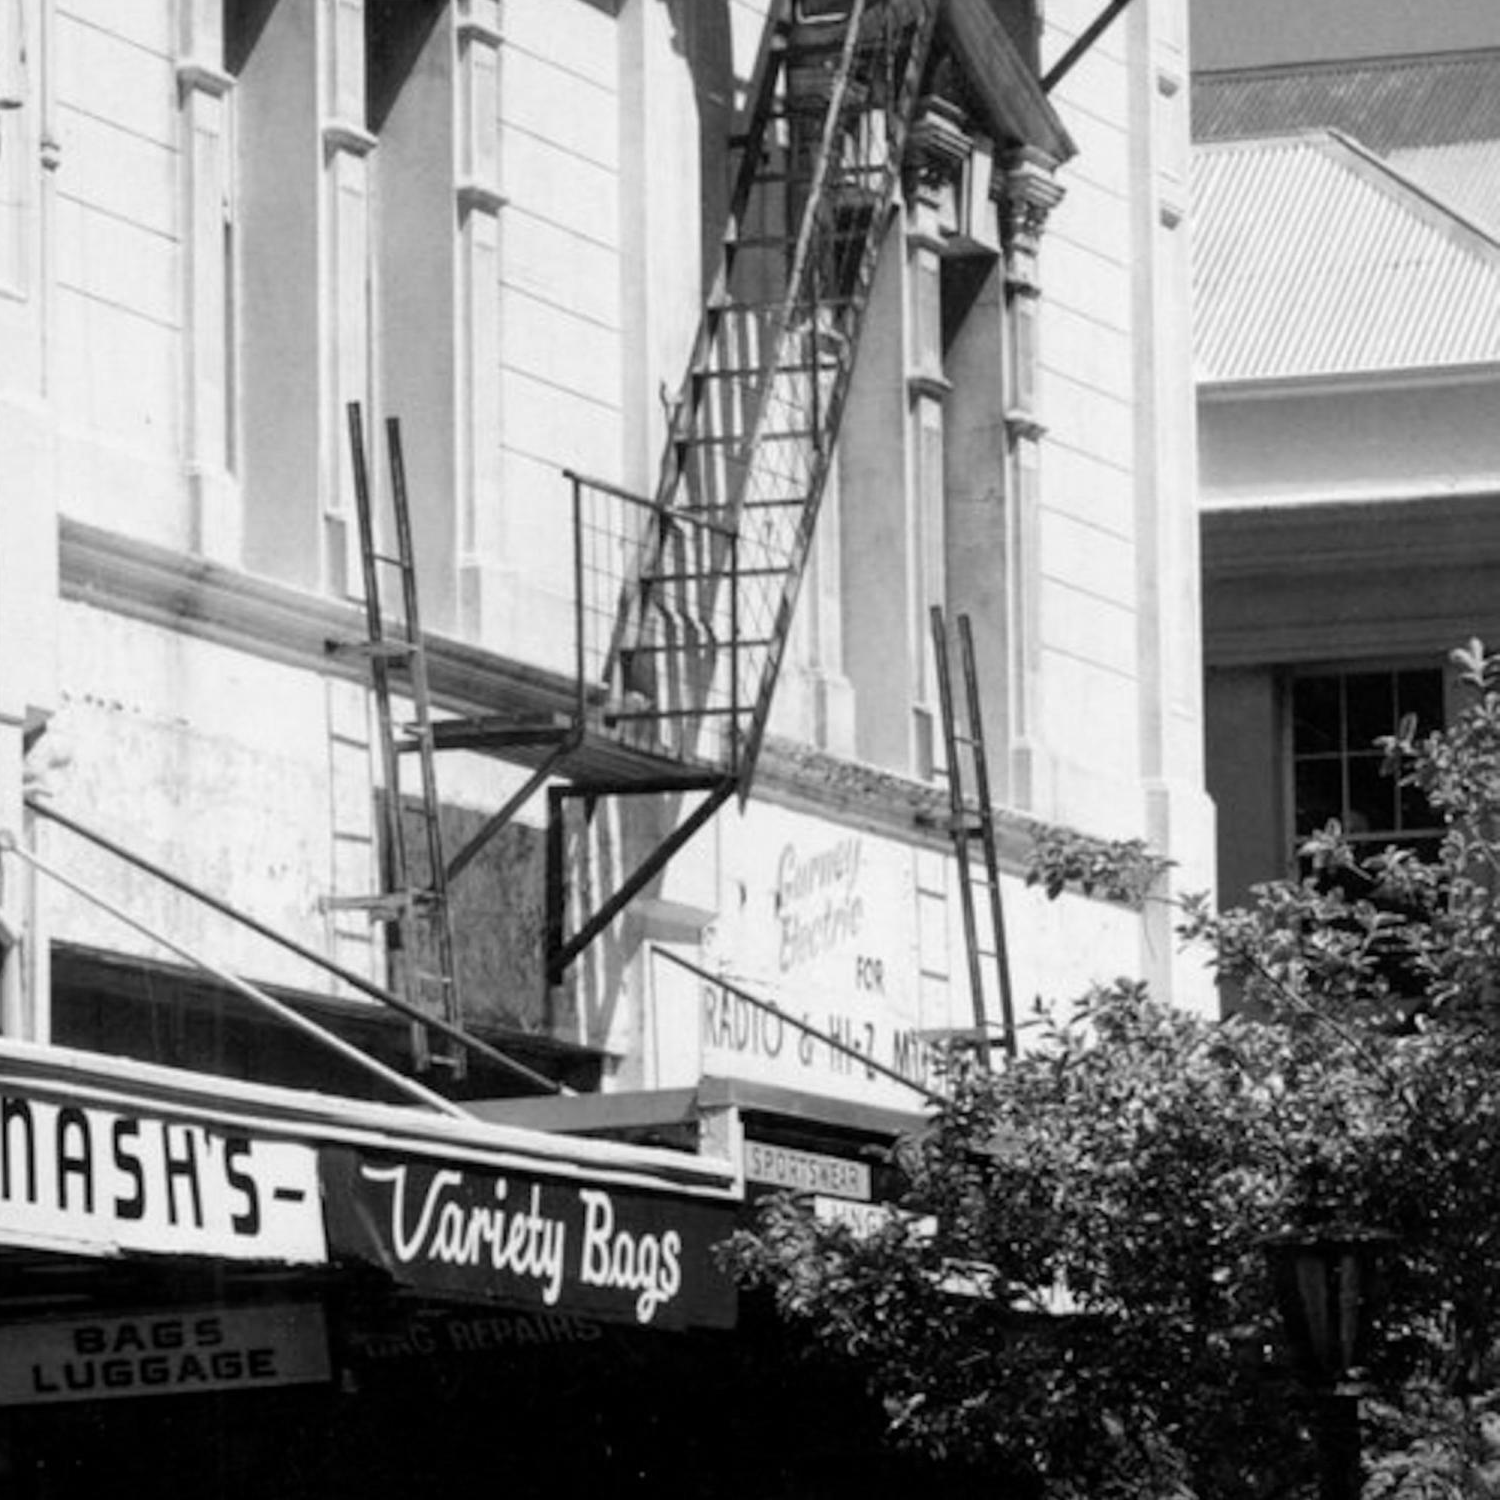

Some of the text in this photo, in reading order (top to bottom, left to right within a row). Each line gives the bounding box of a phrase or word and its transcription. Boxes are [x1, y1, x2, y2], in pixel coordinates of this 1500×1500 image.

[855, 954, 884, 997] FOR
[703, 985, 783, 1058] RADIO
[360, 1163, 681, 1324] Variety Bags
[73, 1316, 225, 1357] BAGS
[447, 1314, 604, 1352] REPAIRS
[31, 1348, 279, 1395] LUGGAGE
